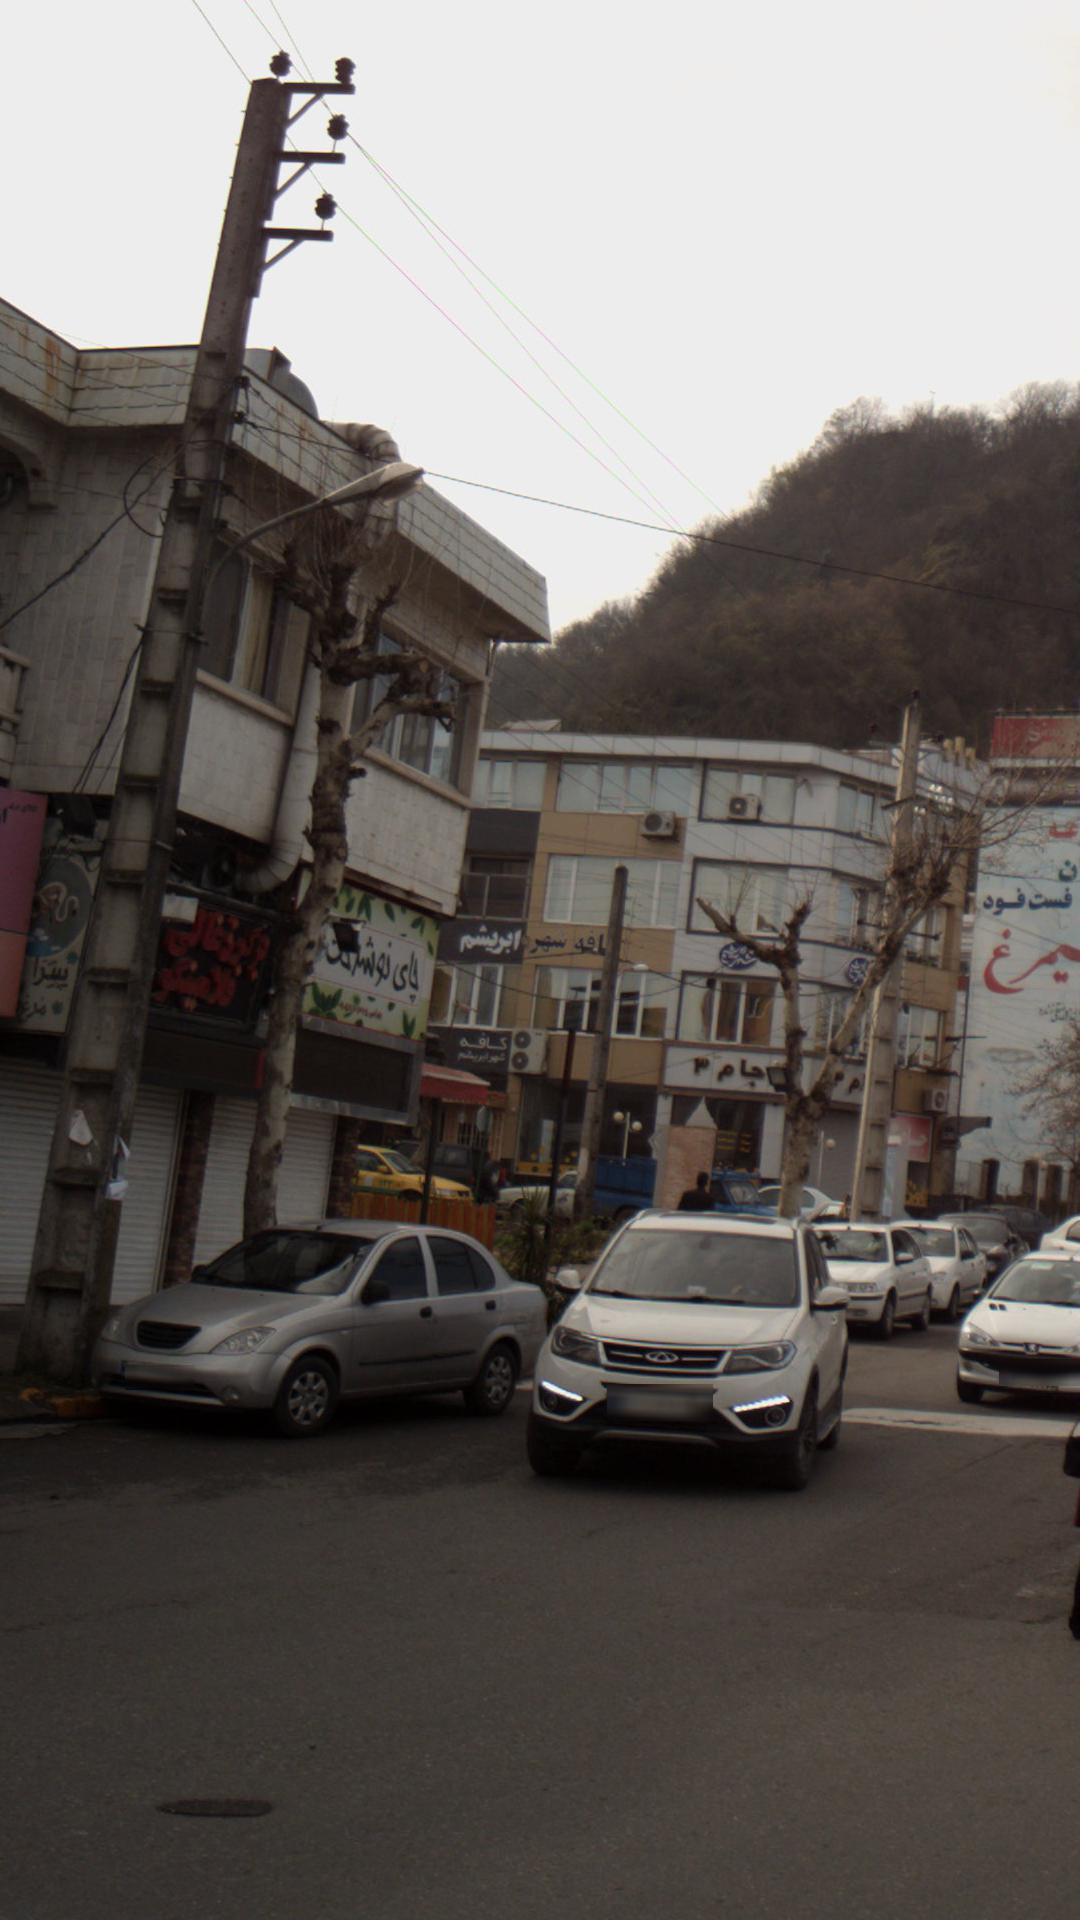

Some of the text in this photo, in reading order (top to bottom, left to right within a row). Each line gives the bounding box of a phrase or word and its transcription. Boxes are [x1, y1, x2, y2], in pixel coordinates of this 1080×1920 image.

[983, 888, 1073, 915] فست فود
[459, 925, 522, 954] ابریشم
[575, 930, 607, 955] افه
[393, 950, 419, 1002] چای
[459, 1032, 508, 1050] کافه
[717, 1059, 765, 1087] جام
